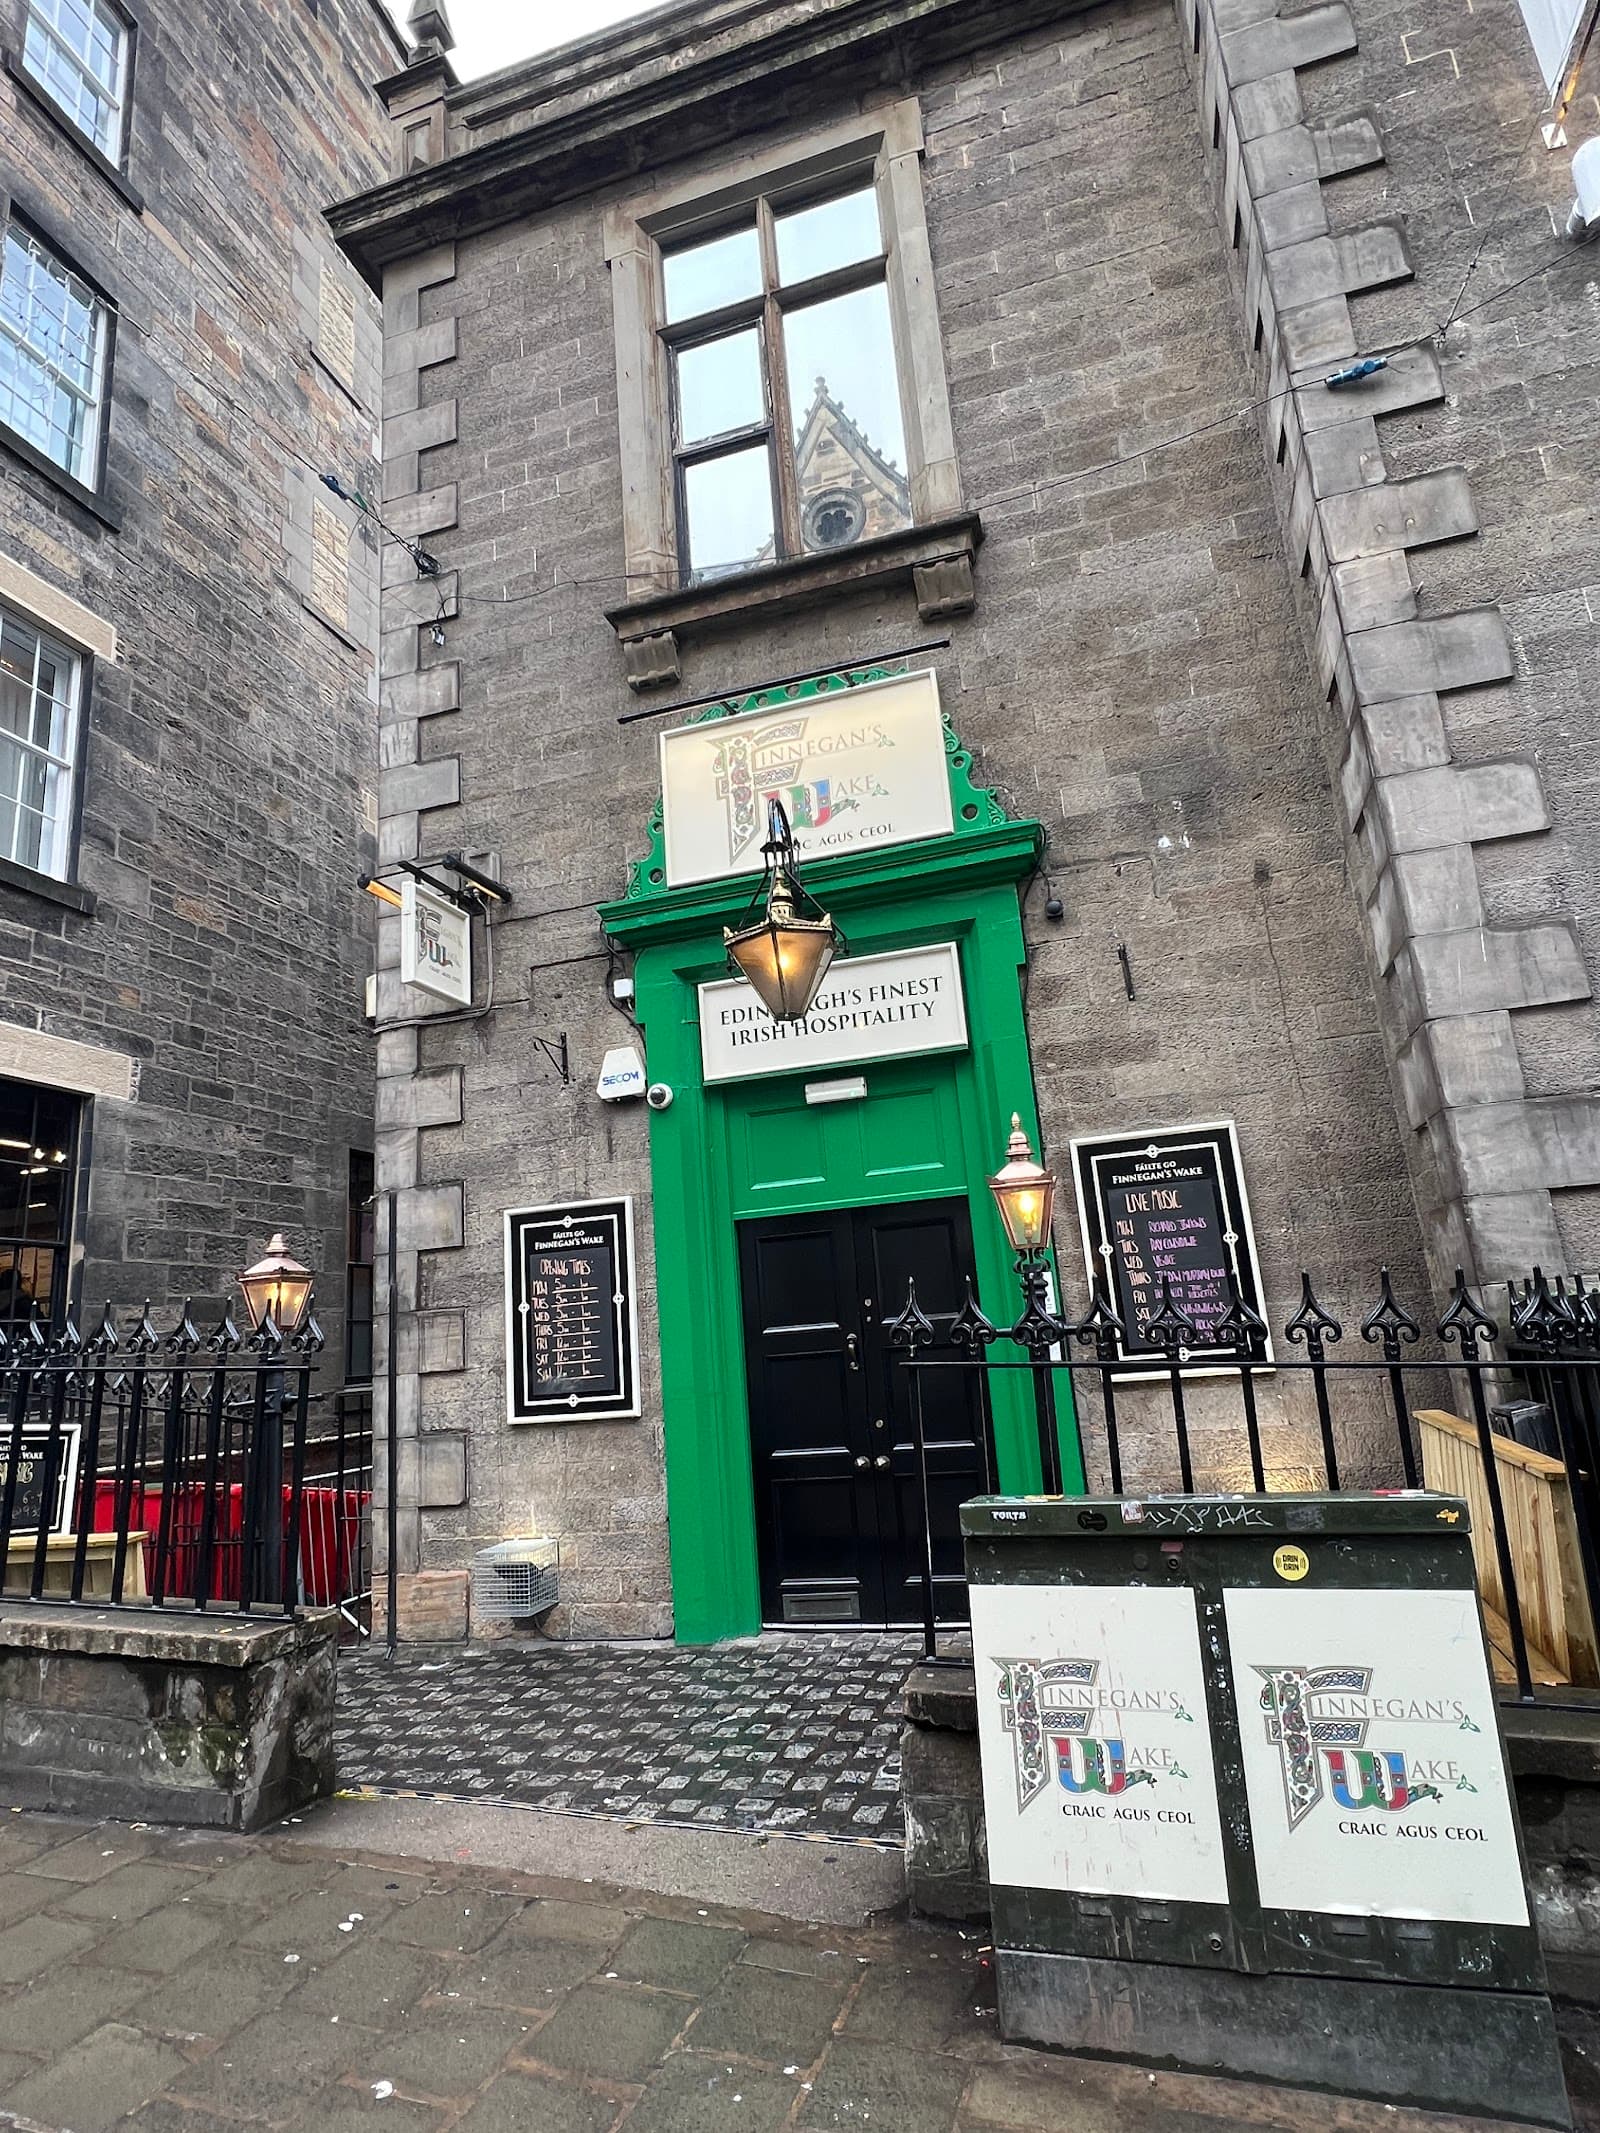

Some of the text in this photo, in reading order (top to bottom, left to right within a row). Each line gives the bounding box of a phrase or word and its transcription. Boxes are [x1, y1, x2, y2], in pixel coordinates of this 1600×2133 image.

[706, 717, 882, 866] FINNEGAN'S
[761, 775, 876, 831] WAKE
[819, 824, 896, 846] AGUS CEOL
[720, 976, 943, 1026] EDINGH'S FINEST
[731, 1000, 936, 1046] IRISH HOSPITALITY
[602, 1071, 639, 1086] SECOM
[1112, 1166, 1203, 1184] FINNEGAN'S WAKE
[1125, 1189, 1182, 1213] LIVE MUSIC
[535, 1236, 604, 1250] FINNEGAN'S WAKE
[1124, 1255, 1143, 1269] WED
[1132, 1290, 1147, 1304] FRI
[534, 1312, 550, 1322] WED
[1135, 1307, 1151, 1321] SAT
[536, 1337, 548, 1350] FRI
[535, 1353, 549, 1366] SAT
[990, 1656, 1179, 1815] FINNEGAN'S
[1250, 1664, 1465, 1834] FINNEGAN'S
[1050, 1737, 1172, 1796] WAKE
[1320, 1749, 1460, 1812] WAKE
[1062, 1804, 1195, 1824] CRAIC AGUS CEOL
[1338, 1821, 1488, 1841] CRAIC AGUS CEOL
